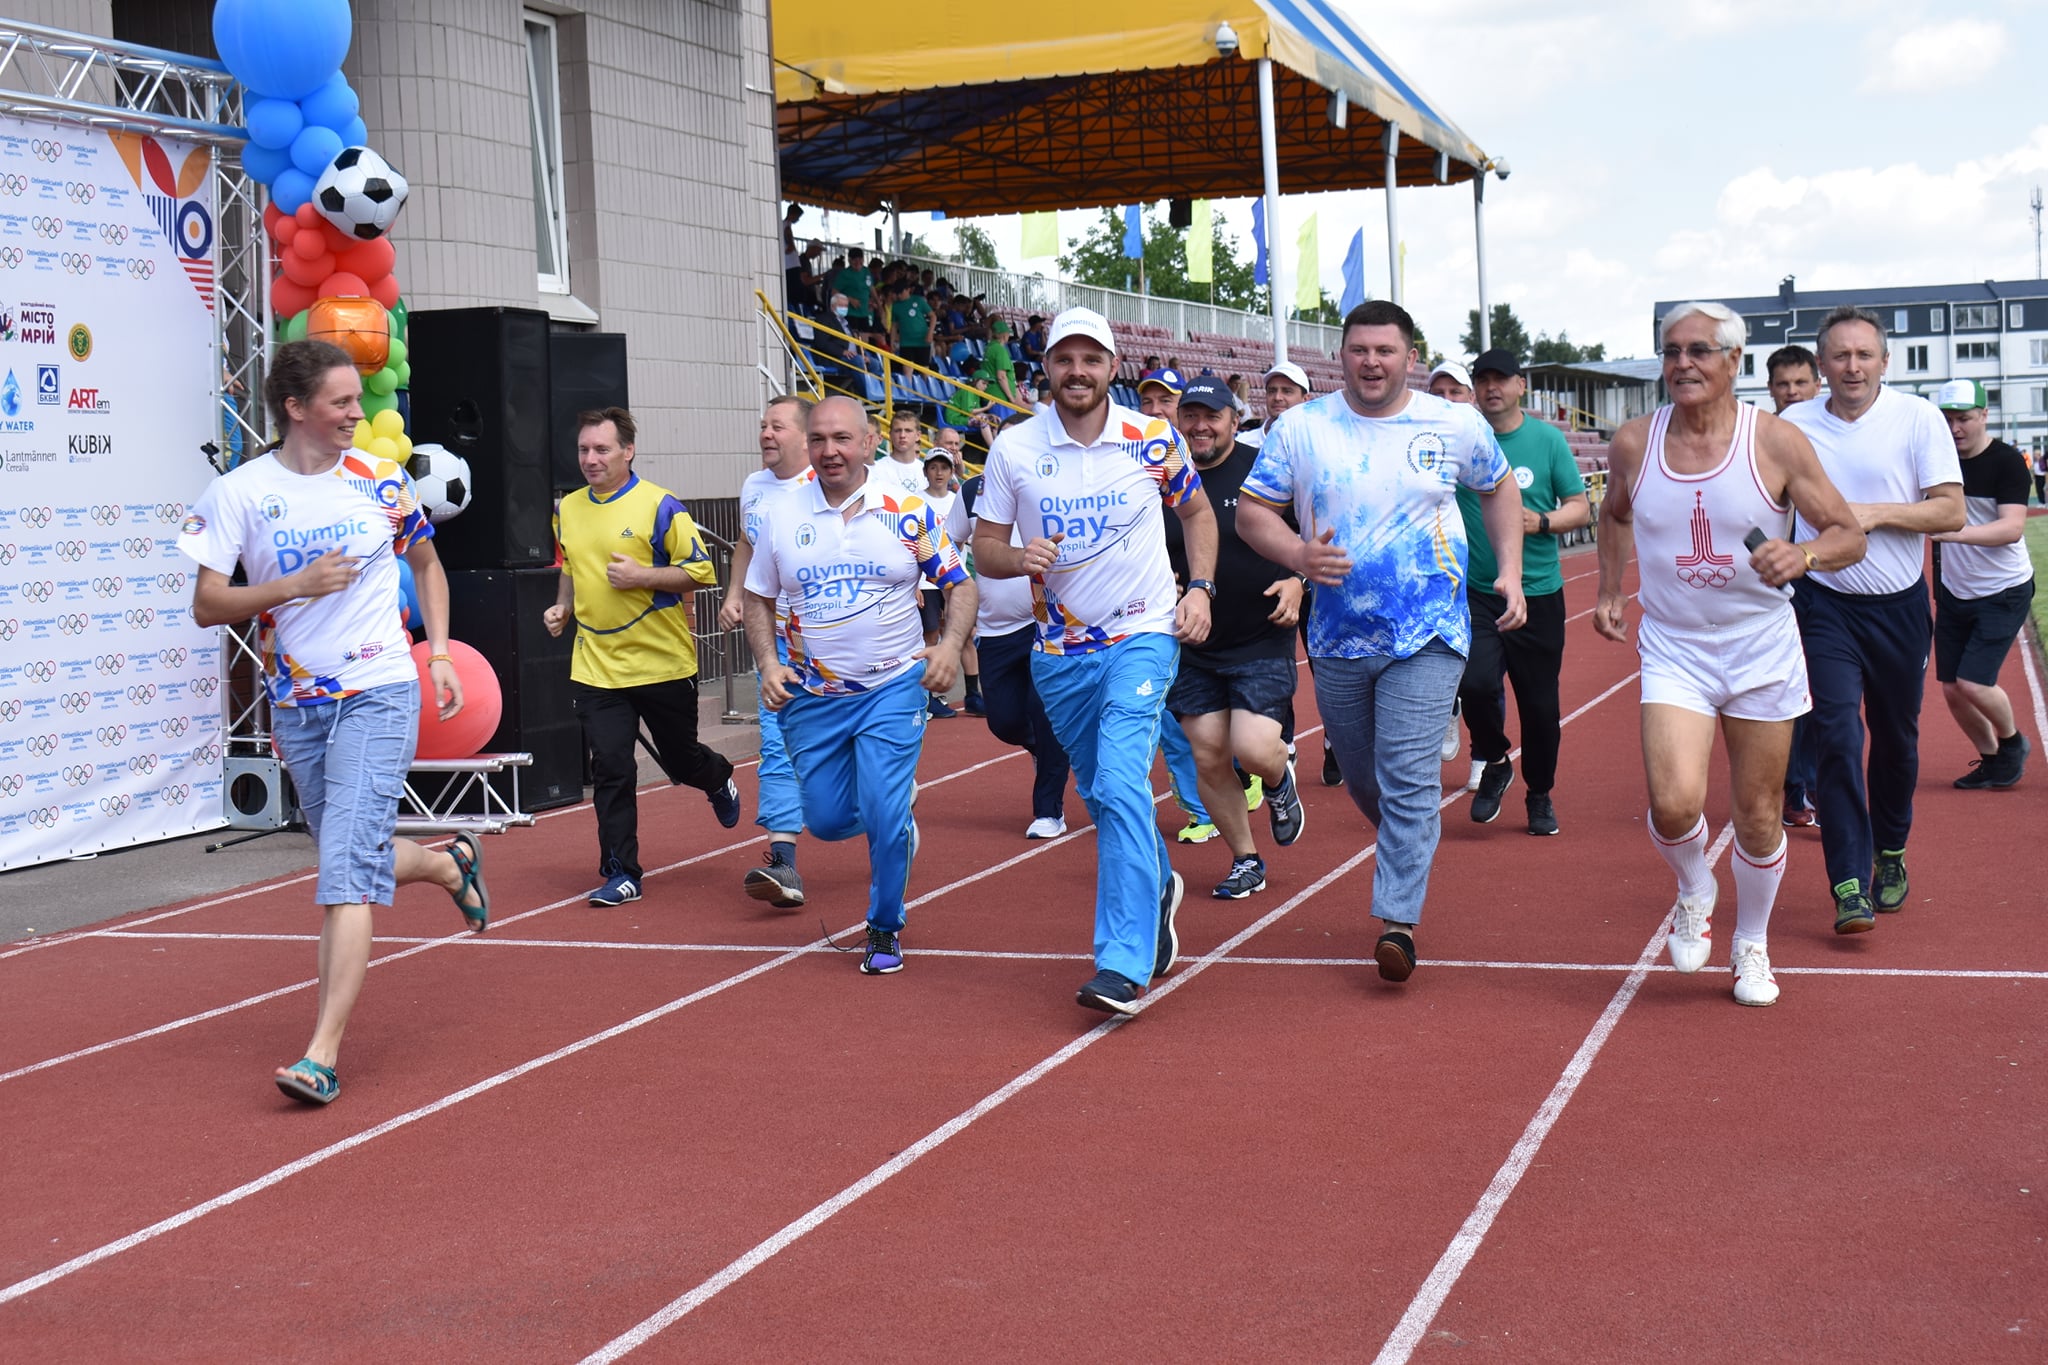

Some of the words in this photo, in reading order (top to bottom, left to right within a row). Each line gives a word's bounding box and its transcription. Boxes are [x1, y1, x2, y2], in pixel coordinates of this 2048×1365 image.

[21, 310, 54, 325] МІСТО
[21, 326, 55, 344] МРІЙ
[6, 421, 34, 431] WATER
[6, 450, 56, 462] Lantmännen
[1040, 490, 1128, 515] Olympic
[273, 519, 368, 548] Olympic
[1042, 514, 1108, 543] Day
[1057, 554, 1068, 562] 21
[796, 561, 886, 582] Olympic
[802, 578, 865, 604] Day
